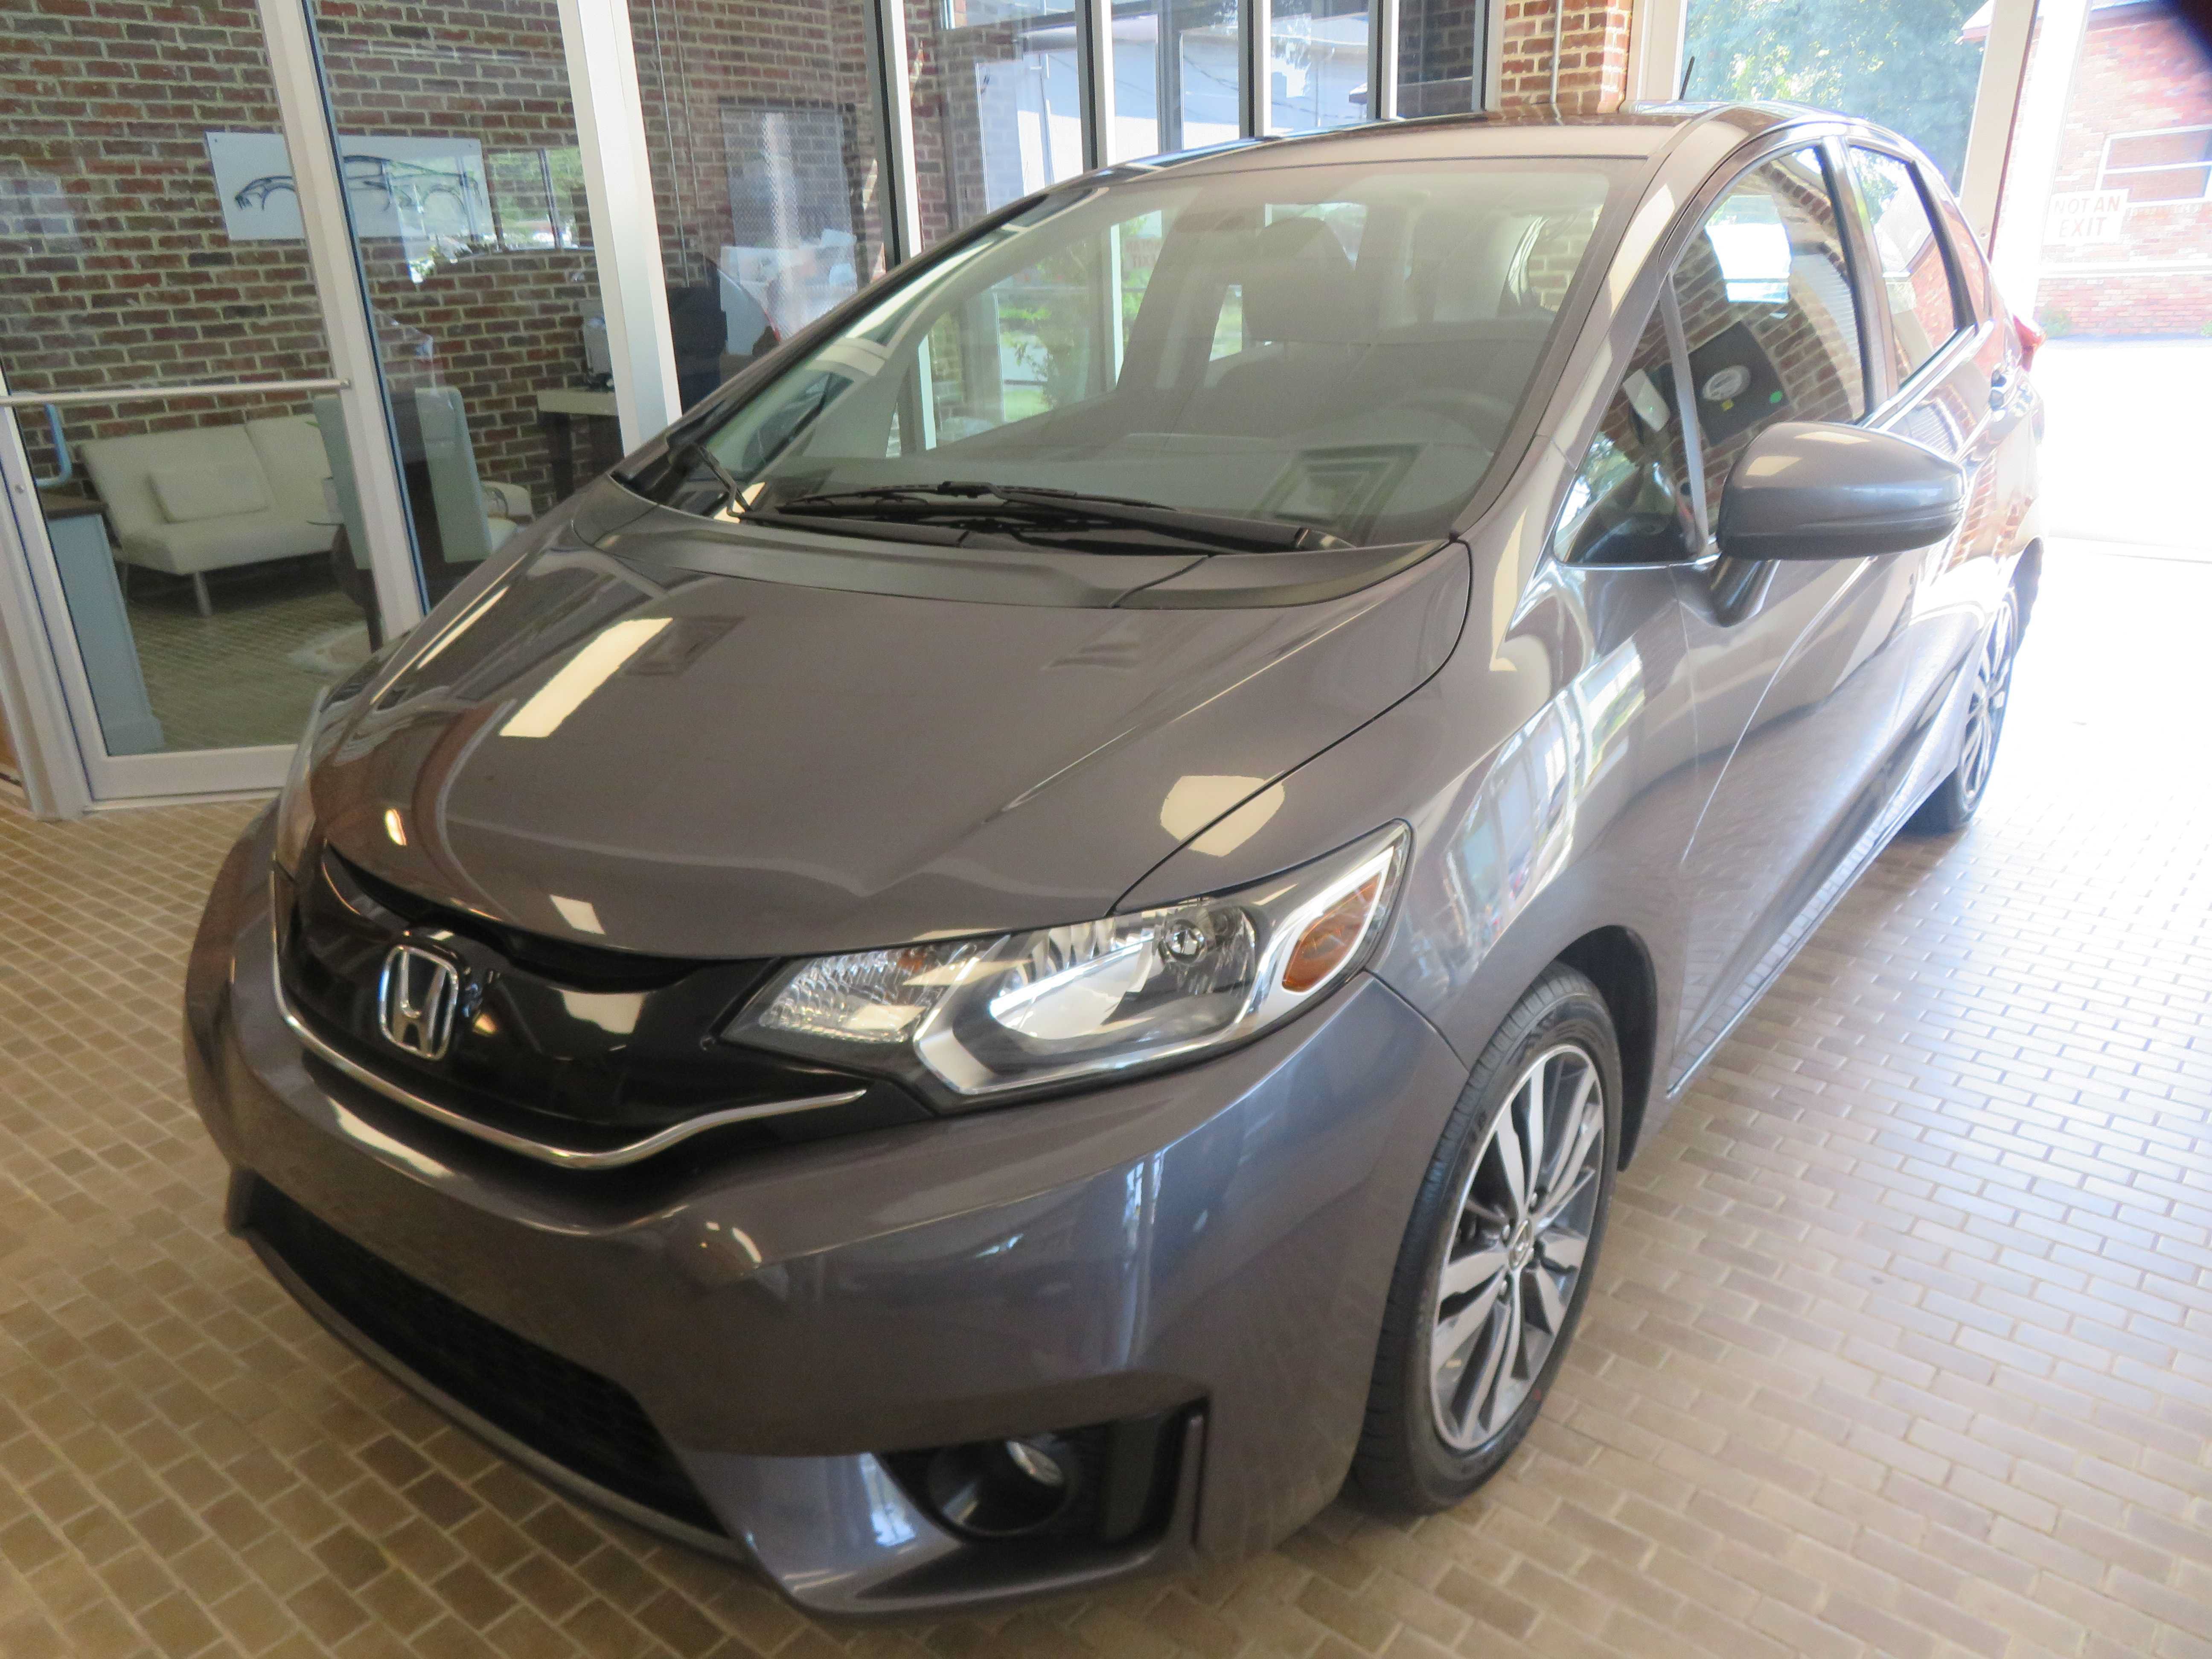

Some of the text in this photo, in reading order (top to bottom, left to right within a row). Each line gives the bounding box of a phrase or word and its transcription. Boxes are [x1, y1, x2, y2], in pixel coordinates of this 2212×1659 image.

[2055, 196, 2121, 214] NOT AN
[2059, 217, 2107, 238] EXIT
